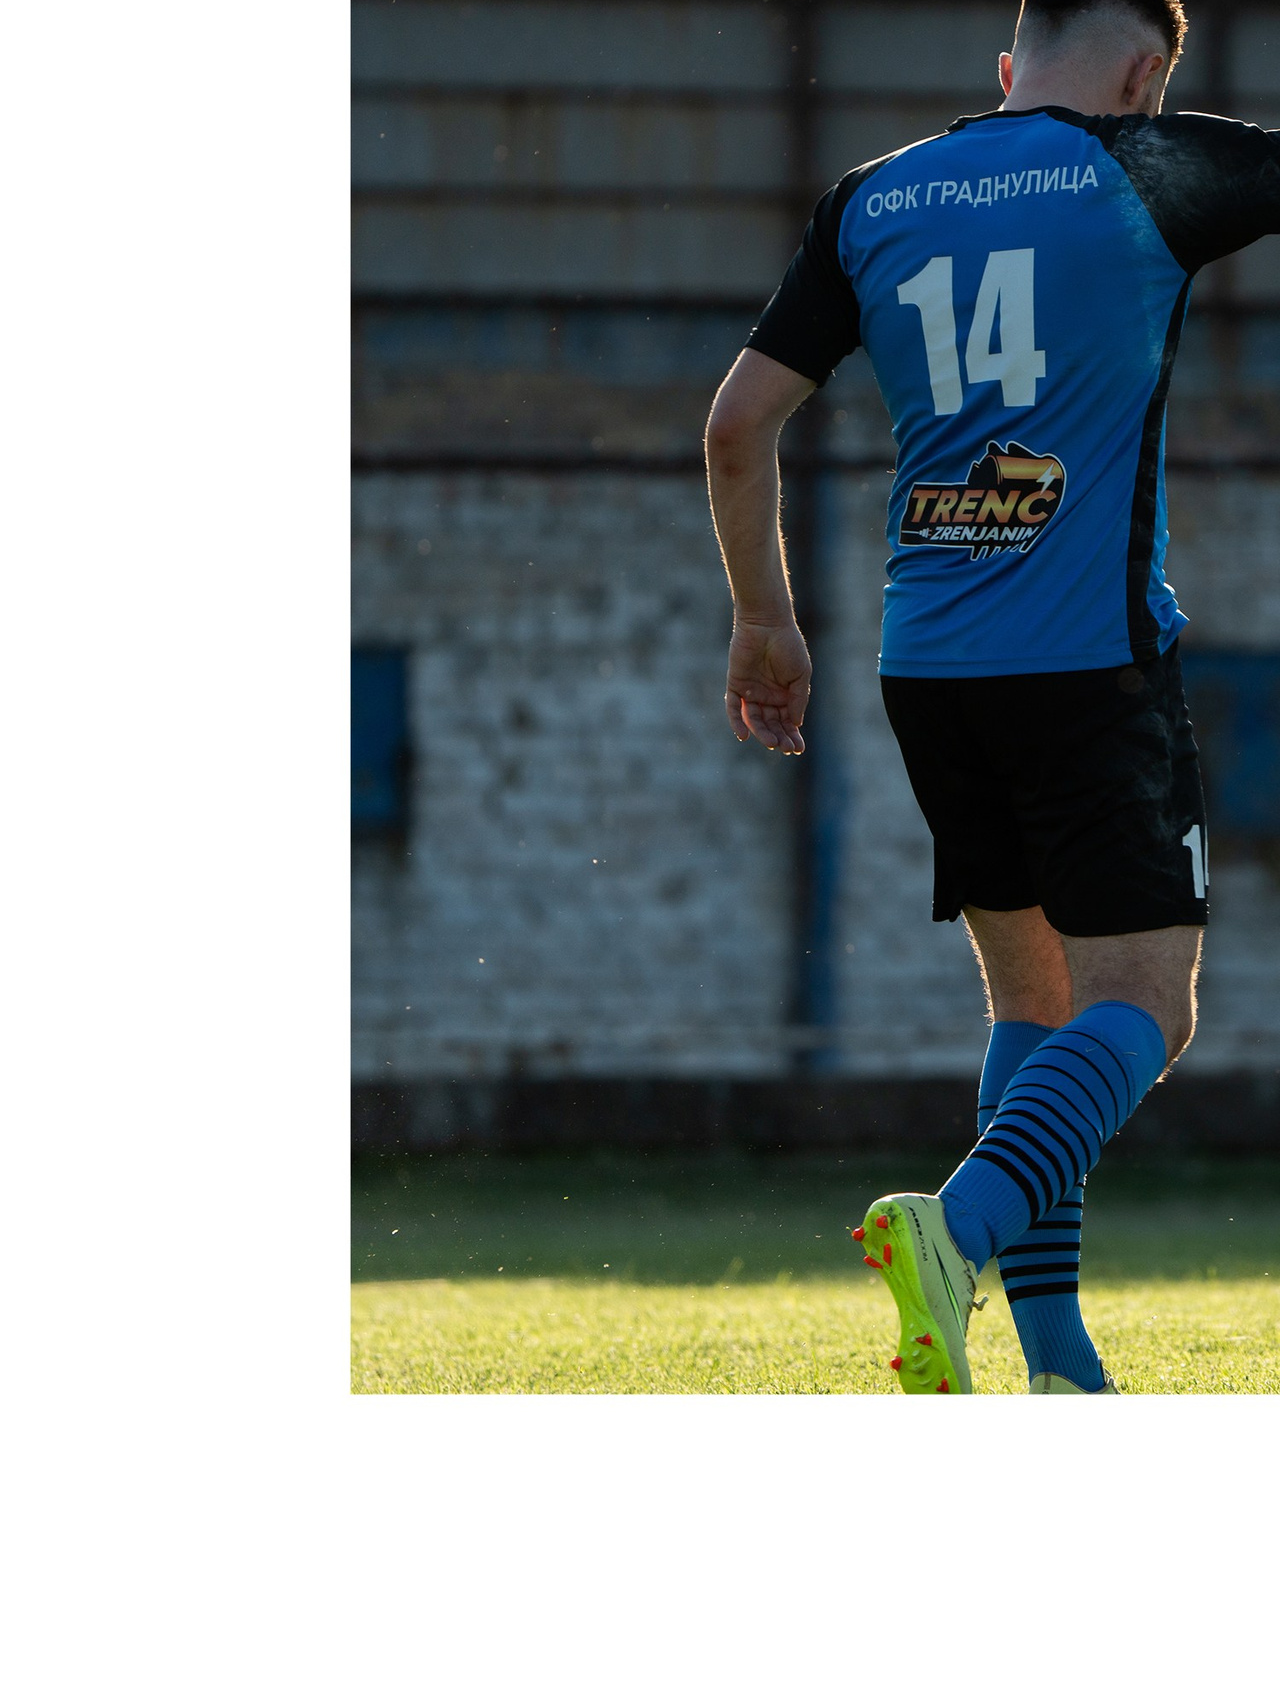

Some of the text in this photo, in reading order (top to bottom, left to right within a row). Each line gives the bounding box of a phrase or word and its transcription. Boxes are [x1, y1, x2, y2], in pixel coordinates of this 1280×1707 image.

[866, 164, 1099, 218] ОФК ГРАДНУЛИЦА
[896, 247, 1046, 416] 14
[1182, 824, 1209, 898] 1
